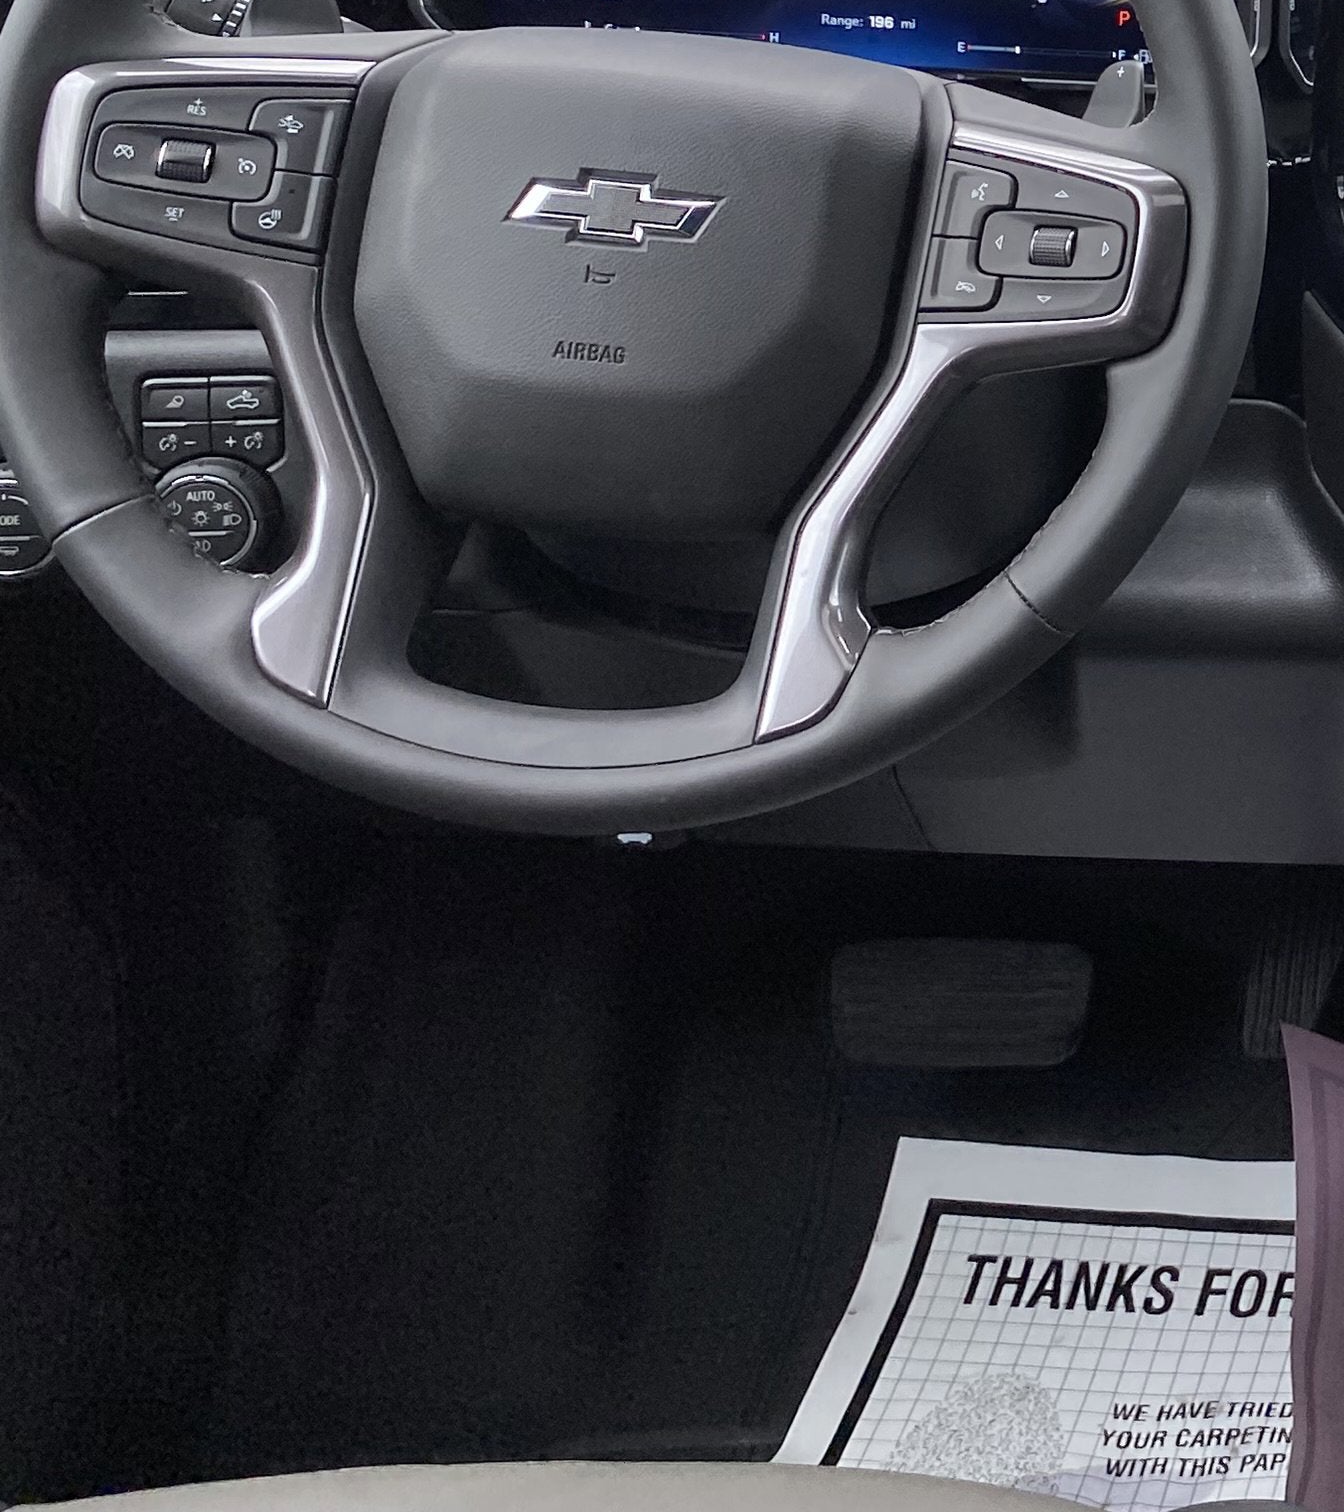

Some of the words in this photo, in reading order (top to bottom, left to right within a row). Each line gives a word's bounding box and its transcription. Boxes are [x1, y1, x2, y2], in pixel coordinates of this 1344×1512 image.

[821, 14, 864, 29] Range:
[869, 15, 894, 29] 196
[901, 19, 916, 30] mi
[1118, 10, 1131, 27] P
[769, 32, 779, 43] H
[957, 41, 966, 53] E
[1118, 49, 1126, 61] F
[187, 104, 207, 116] RES
[165, 206, 185, 219] SET
[552, 340, 626, 364] AIRBAG
[186, 490, 216, 502] AUTO
[963, 1254, 1179, 1316] THANKS
[1113, 1402, 1150, 1422] WE
[1156, 1400, 1220, 1422] HAVE
[1227, 1401, 1294, 1418] TRIED
[1103, 1428, 1168, 1449] YOUR
[1175, 1425, 1293, 1448] CARPETIN
[1106, 1456, 1168, 1478] WITH
[1179, 1455, 1231, 1478] THIS
[1239, 1453, 1286, 1473] PAP
